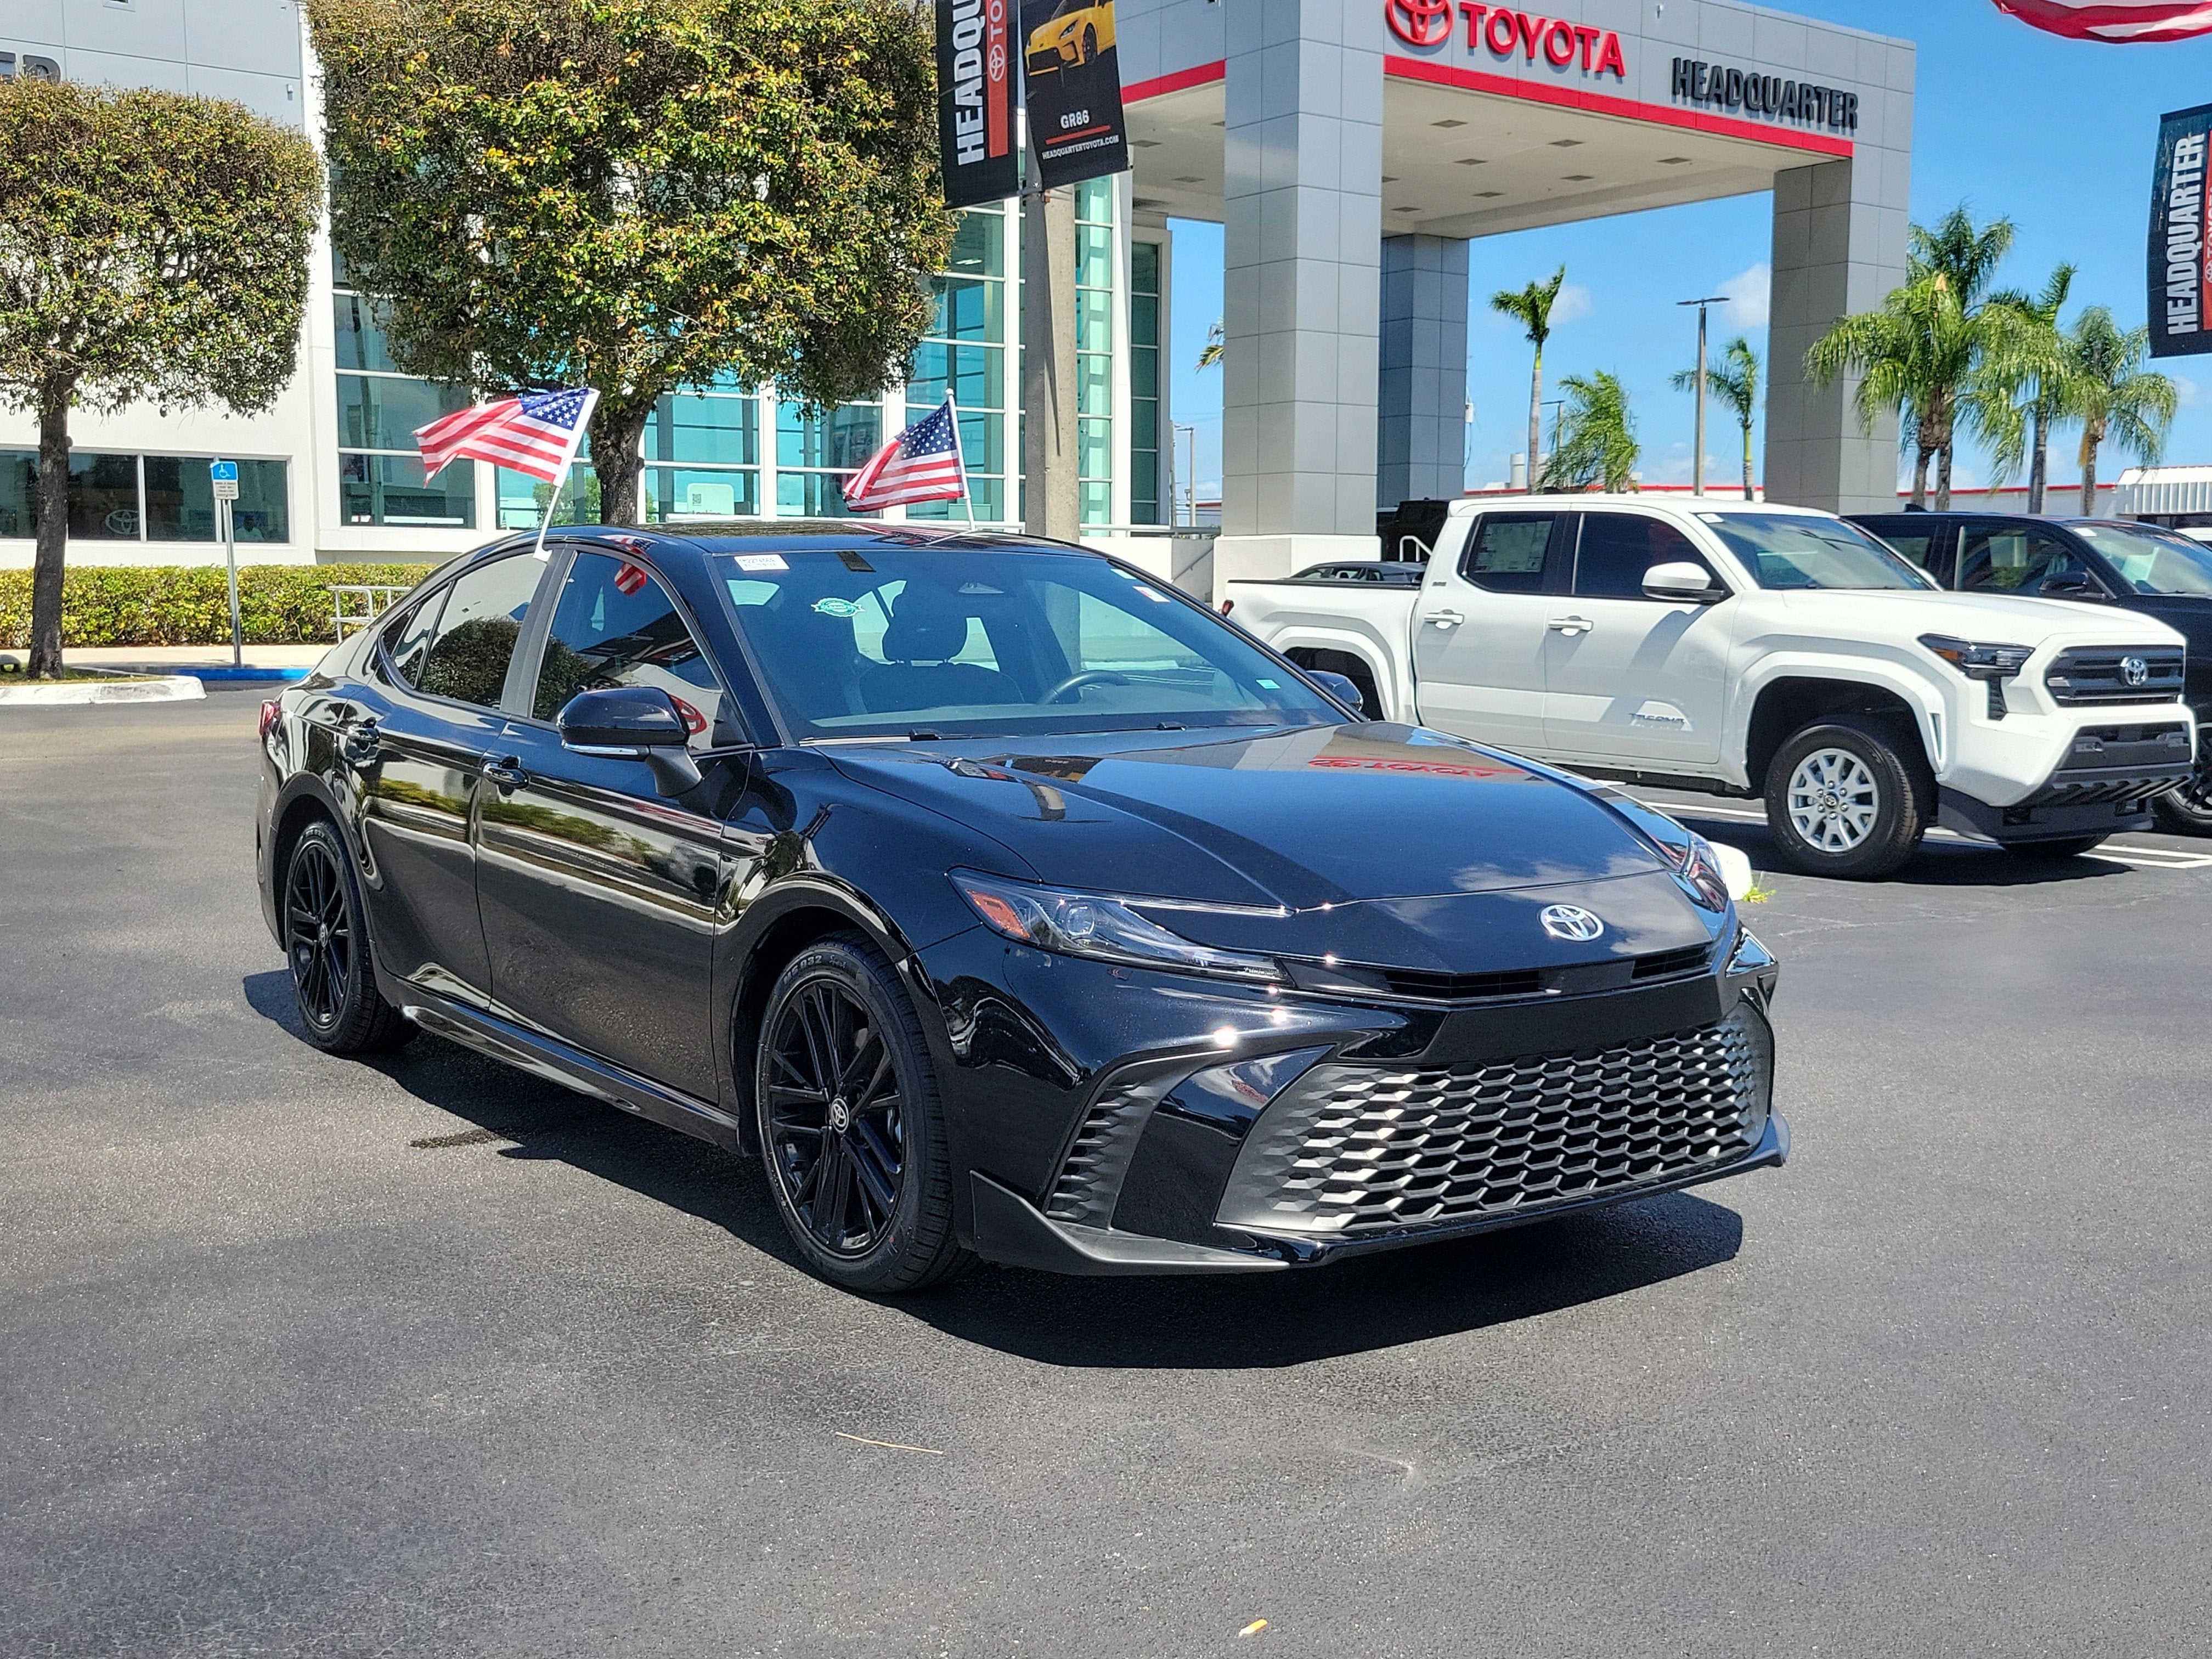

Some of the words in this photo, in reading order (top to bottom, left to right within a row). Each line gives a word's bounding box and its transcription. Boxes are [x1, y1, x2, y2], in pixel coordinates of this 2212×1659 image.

[1459, 2, 1626, 77] TOYOTA
[1060, 110, 1090, 129] GR86
[1673, 57, 1858, 129] HEADQUARTER
[1042, 135, 1120, 160] HEADQUARTERTOYOTA.COM
[2167, 133, 2204, 335] HEADQUARTER
